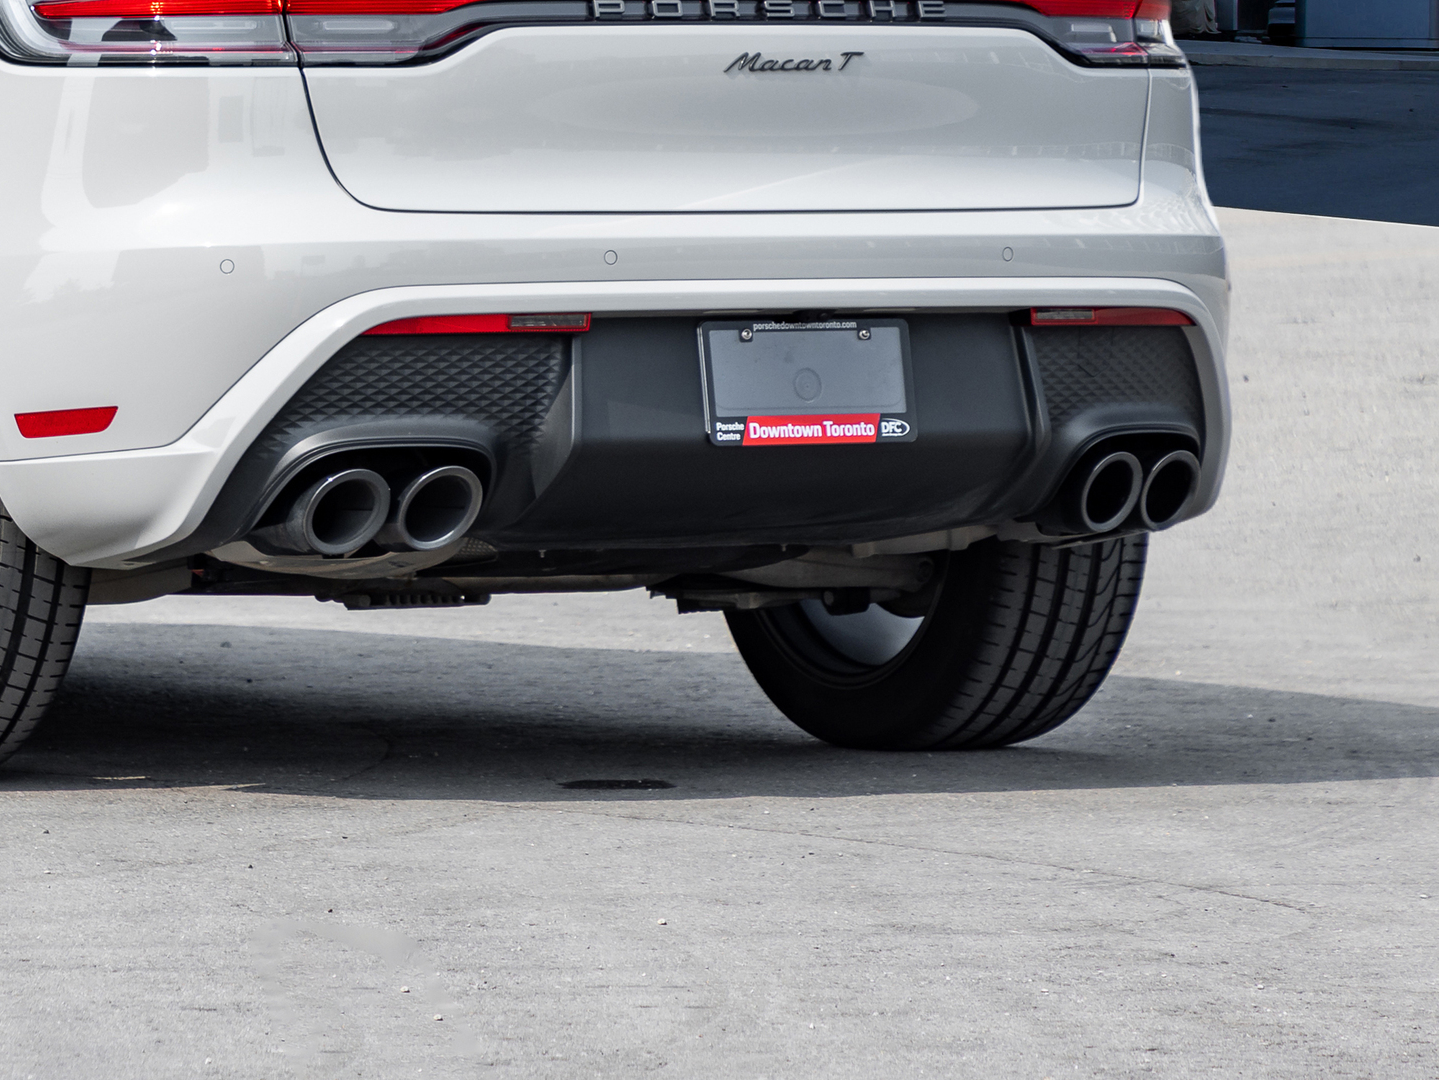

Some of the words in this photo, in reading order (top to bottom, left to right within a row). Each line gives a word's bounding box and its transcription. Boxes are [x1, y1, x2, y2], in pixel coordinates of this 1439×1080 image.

[723, 51, 832, 73] Macan
[837, 51, 865, 71] T
[752, 321, 858, 332] porschedowntowntoronto.com
[716, 422, 745, 431] Porsche
[749, 423, 822, 439] Downtown
[823, 420, 875, 437] Toronto
[881, 421, 903, 433] DFC
[717, 432, 741, 441] Centre
